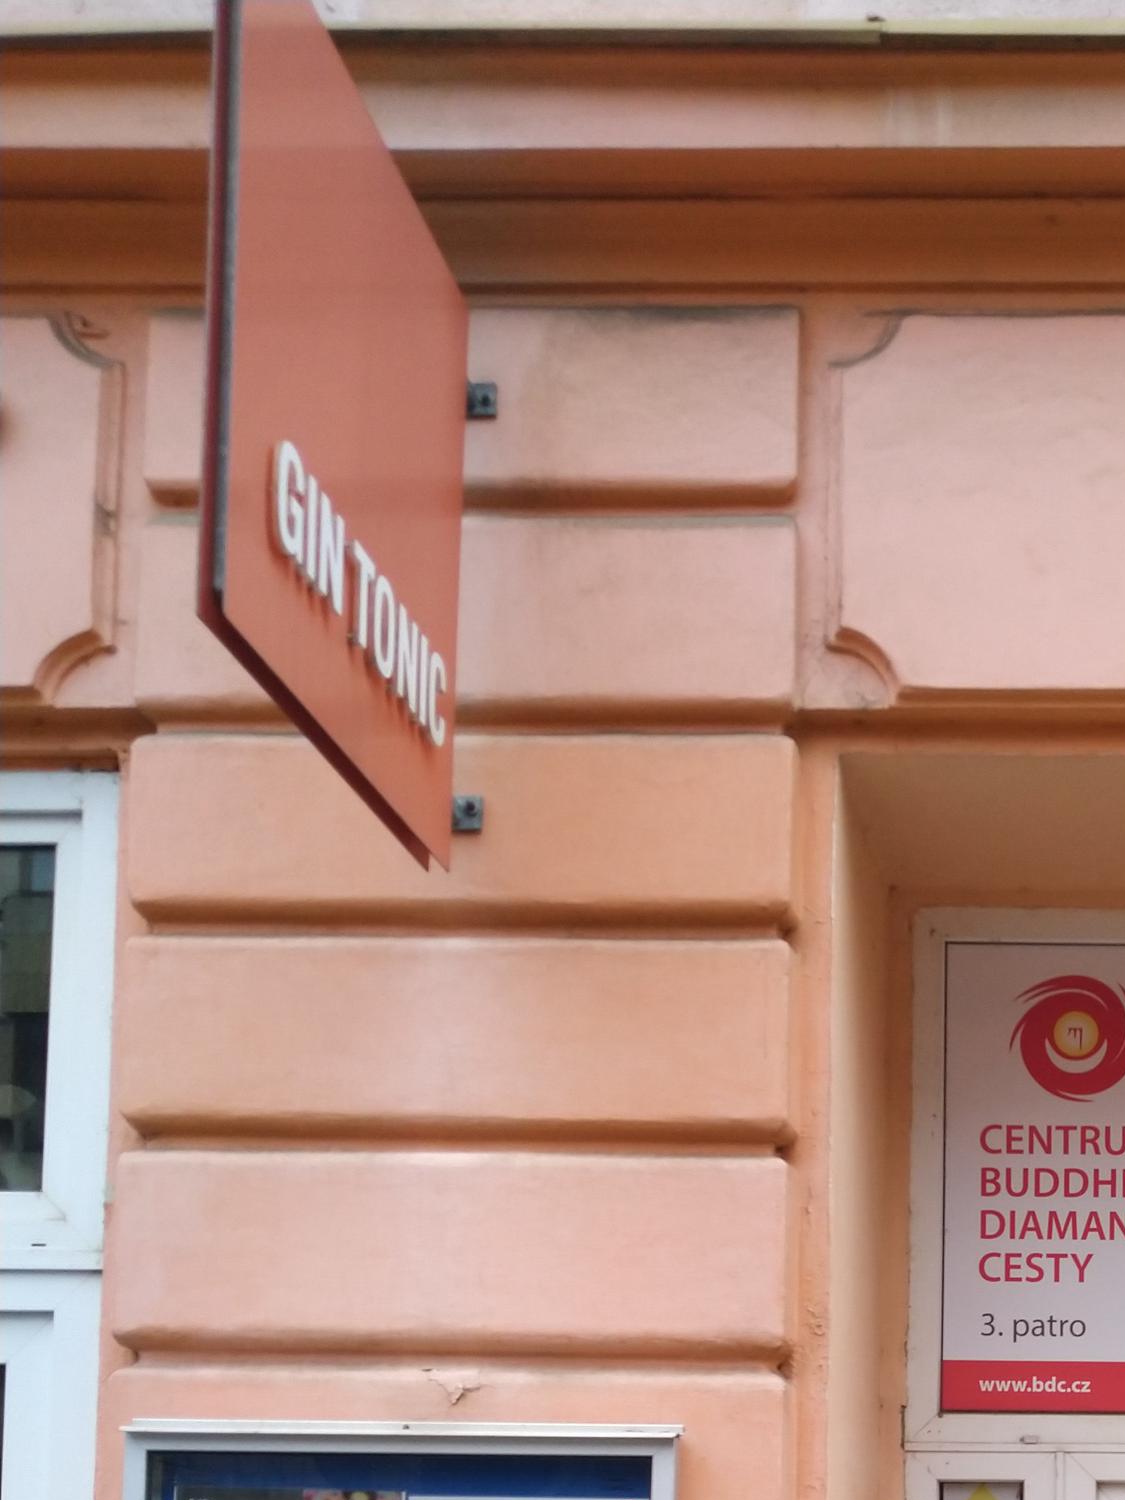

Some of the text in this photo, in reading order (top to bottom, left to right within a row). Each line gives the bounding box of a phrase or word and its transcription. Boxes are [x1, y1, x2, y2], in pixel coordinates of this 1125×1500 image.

[276, 440, 446, 747] GIN TONIC
[979, 1252, 1093, 1283] CESTY
[980, 1313, 1086, 1342] 3. patro
[979, 1376, 1092, 1393] www.bdc.cz
